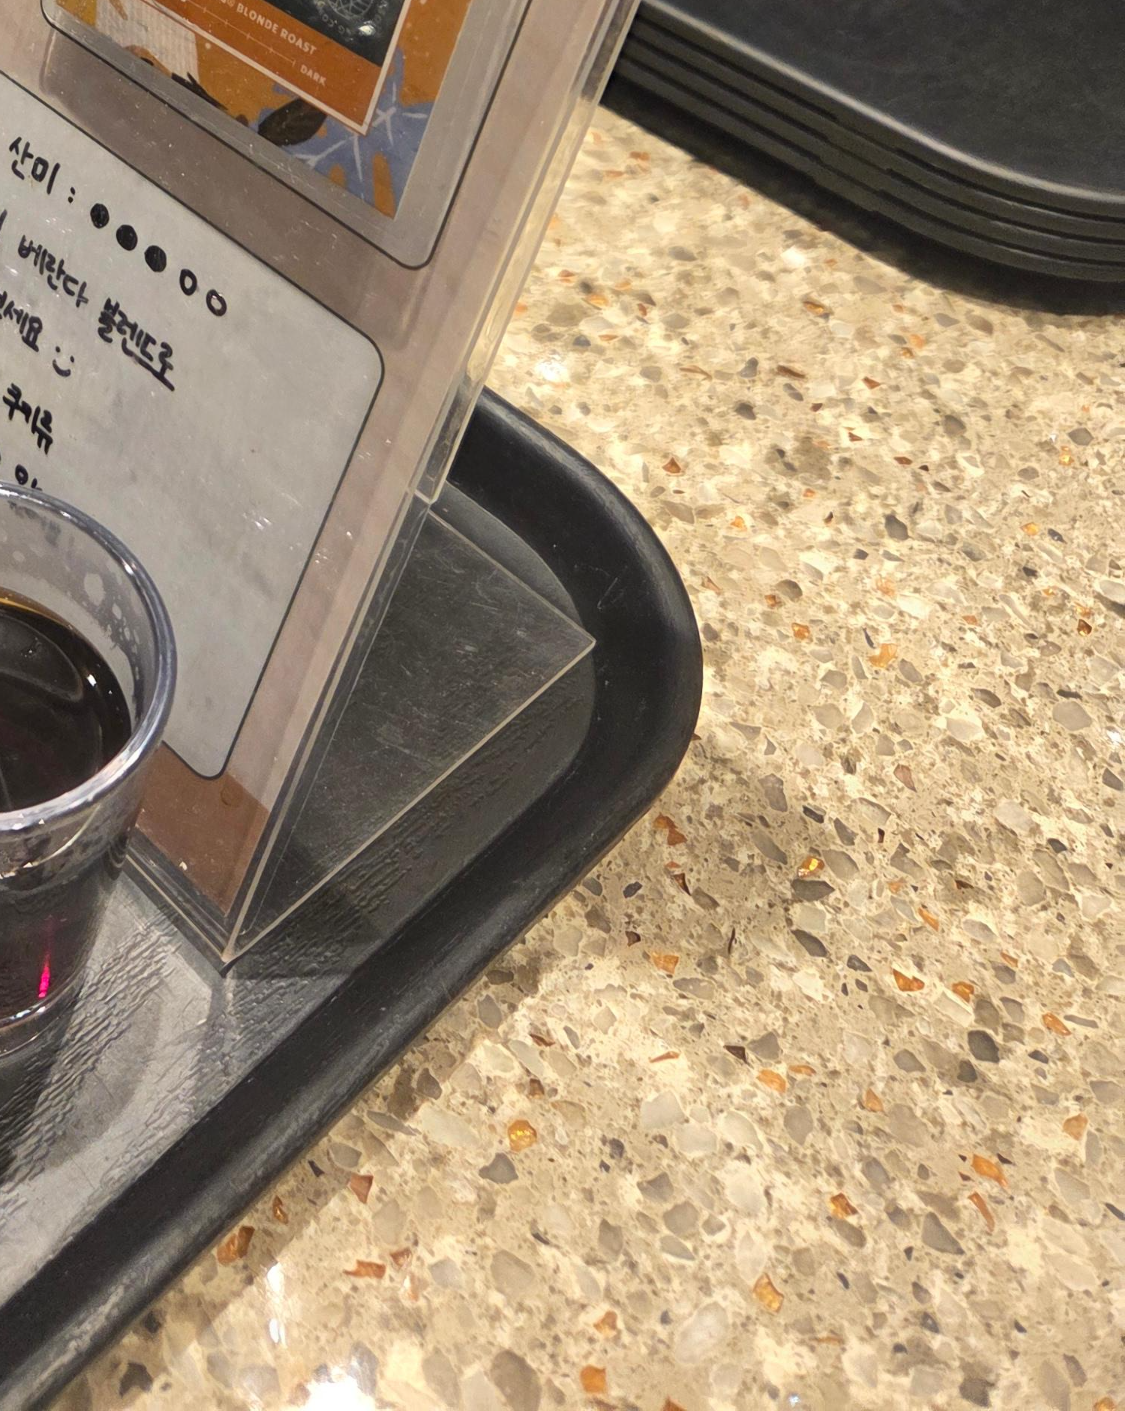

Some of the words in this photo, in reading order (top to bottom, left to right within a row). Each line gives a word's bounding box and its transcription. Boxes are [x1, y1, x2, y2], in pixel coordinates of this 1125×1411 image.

[236, 3, 278, 34] BLONDE
[279, 29, 317, 56] ROAST
[300, 64, 326, 87] DARK
[18, 234, 89, 308] 베란다
[97, 297, 175, 391] 블렌드로
